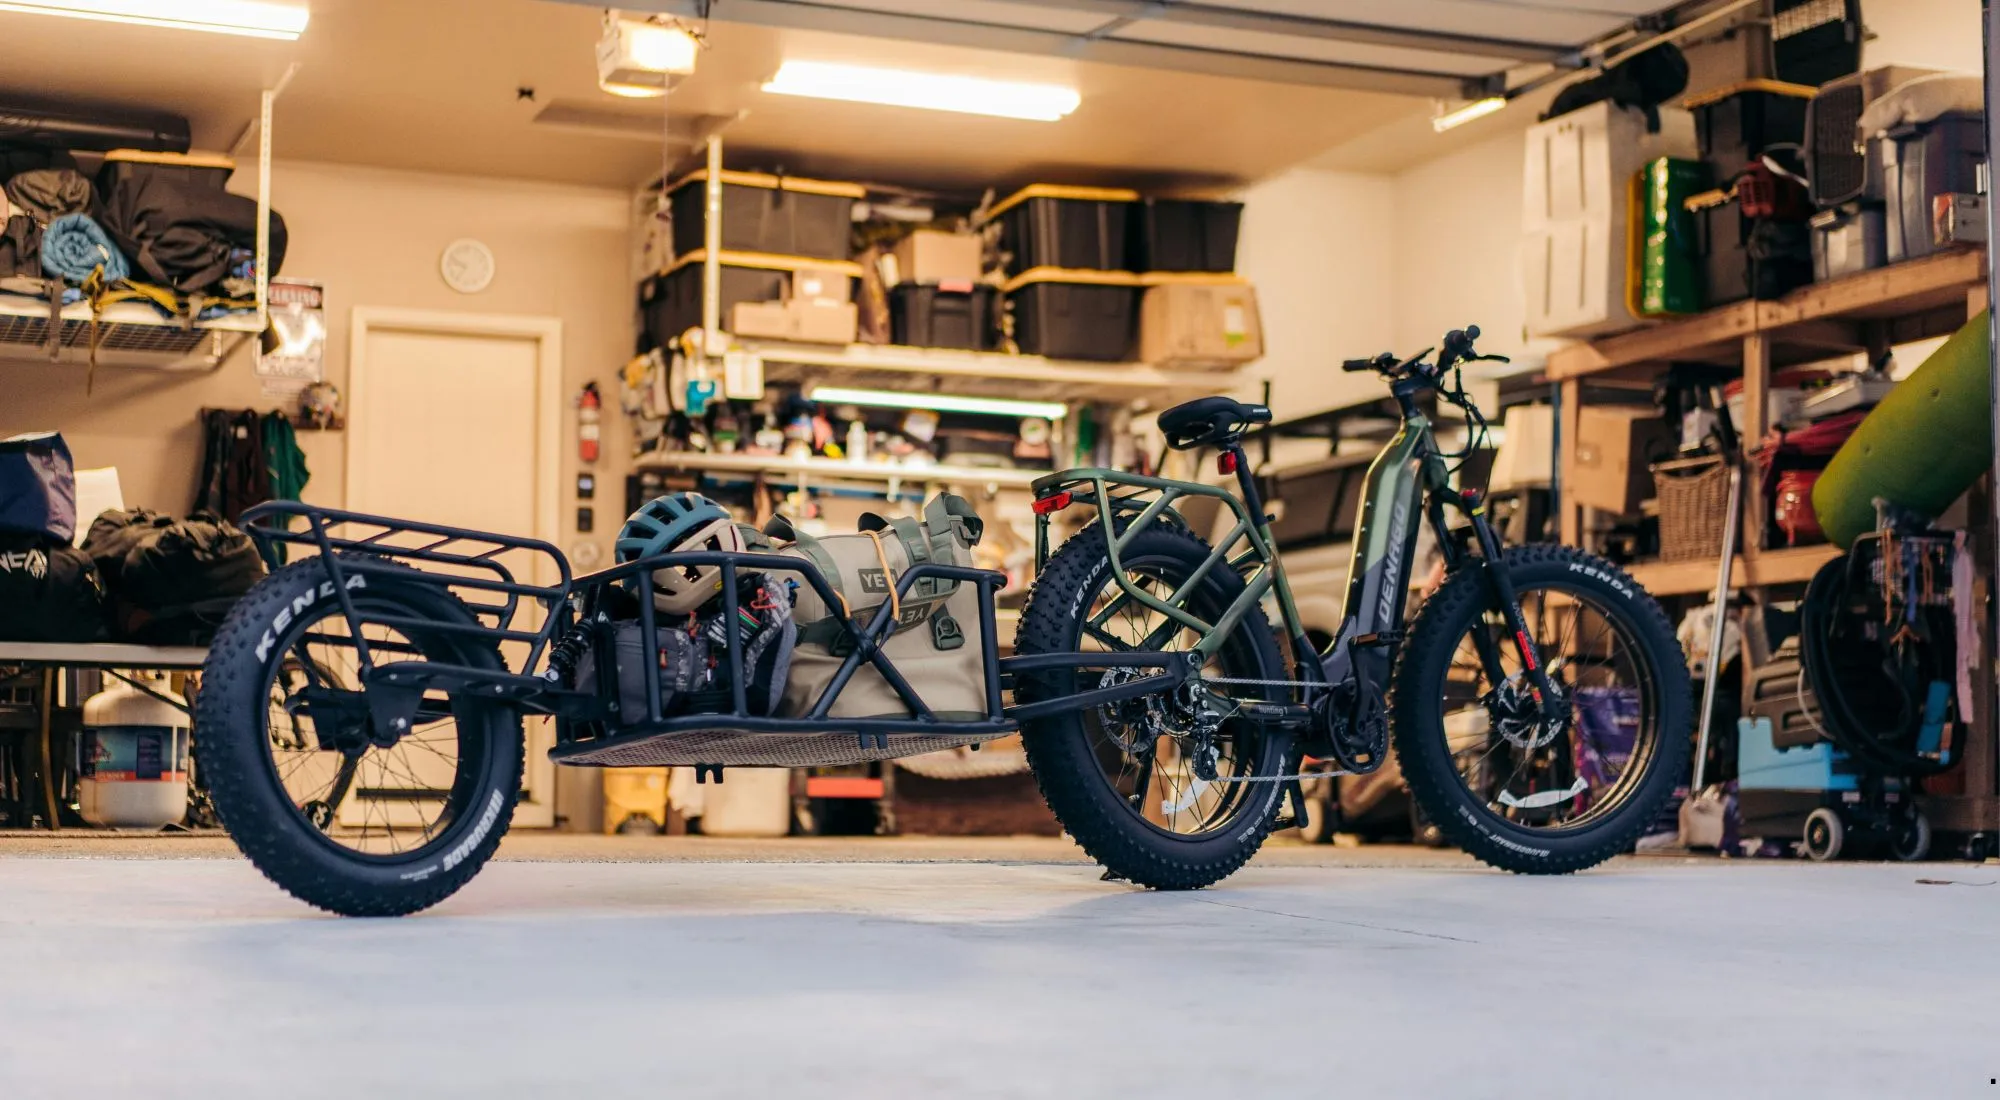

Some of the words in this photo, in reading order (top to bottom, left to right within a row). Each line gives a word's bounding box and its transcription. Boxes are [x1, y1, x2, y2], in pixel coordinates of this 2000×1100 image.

[268, 286, 320, 308] ARNING
[1068, 555, 1109, 620] KENDA
[1378, 501, 1406, 624] DENAGO
[1568, 562, 1634, 601] KENDA
